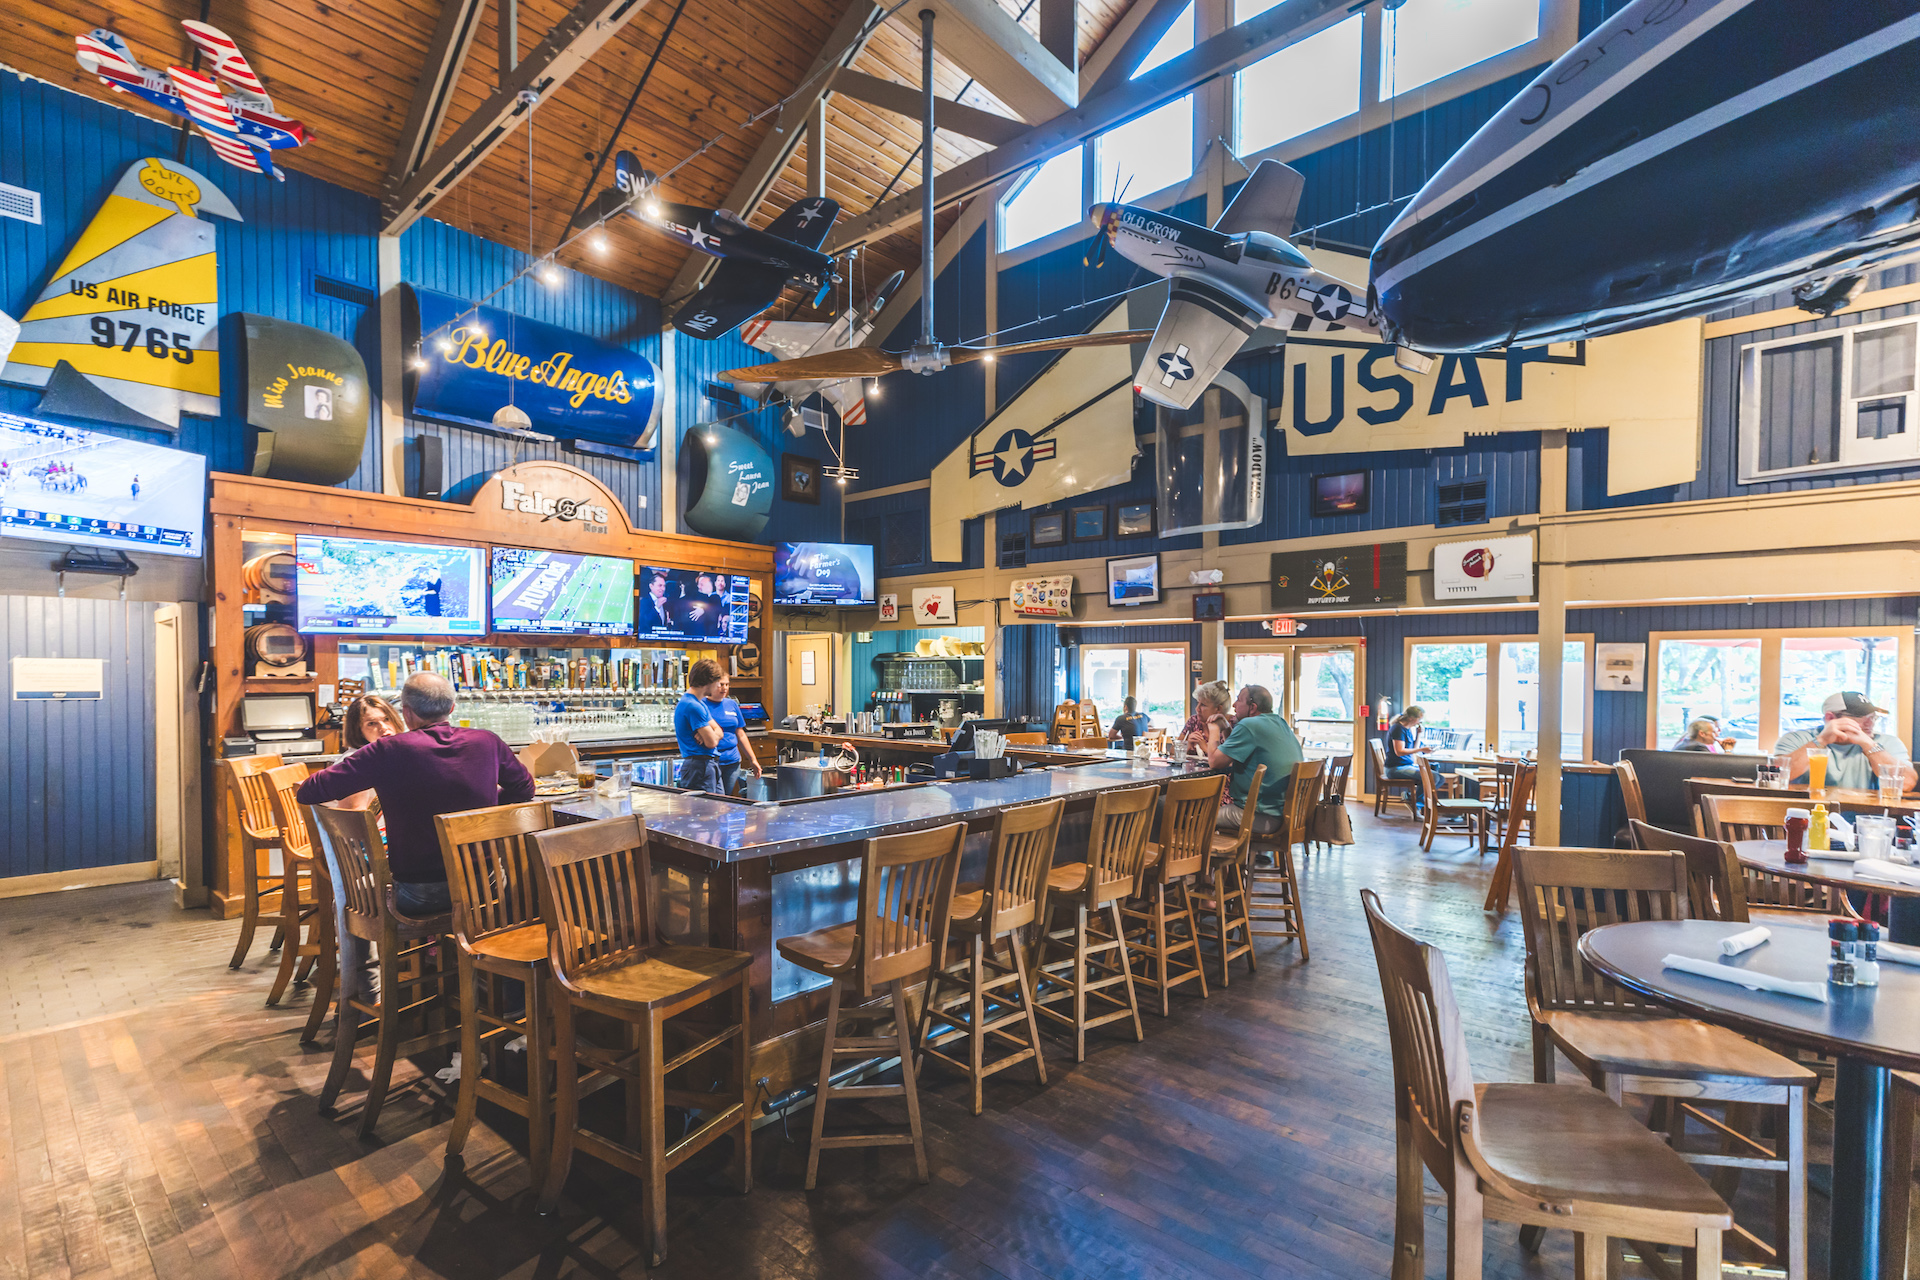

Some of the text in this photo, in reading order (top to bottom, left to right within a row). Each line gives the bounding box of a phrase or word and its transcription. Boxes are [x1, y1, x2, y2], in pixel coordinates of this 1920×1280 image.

[615, 168, 645, 199] SW
[639, 211, 676, 231] MINES
[1122, 211, 1182, 242] OLD CROW
[804, 273, 819, 286] 34
[1264, 272, 1296, 300] B6
[70, 279, 205, 325] US AIR FORCE
[90, 316, 194, 365] 9765
[444, 326, 633, 409] Blue Angels
[262, 363, 344, 409] Miss Jeanne
[1293, 344, 1549, 437] USAF
[728, 460, 754, 475] Sweet
[739, 471, 762, 481] Laura
[751, 481, 770, 494] Jean
[71, 517, 79, 525] 5
[90, 519, 99, 527] 6
[583, 522, 608, 535] Nest
[814, 552, 830, 561] The
[809, 558, 841, 570] Farmer's
[815, 568, 831, 578] Dog
[1307, 595, 1351, 604] RUPTURED DUCK
[1275, 620, 1293, 634] EXIT
